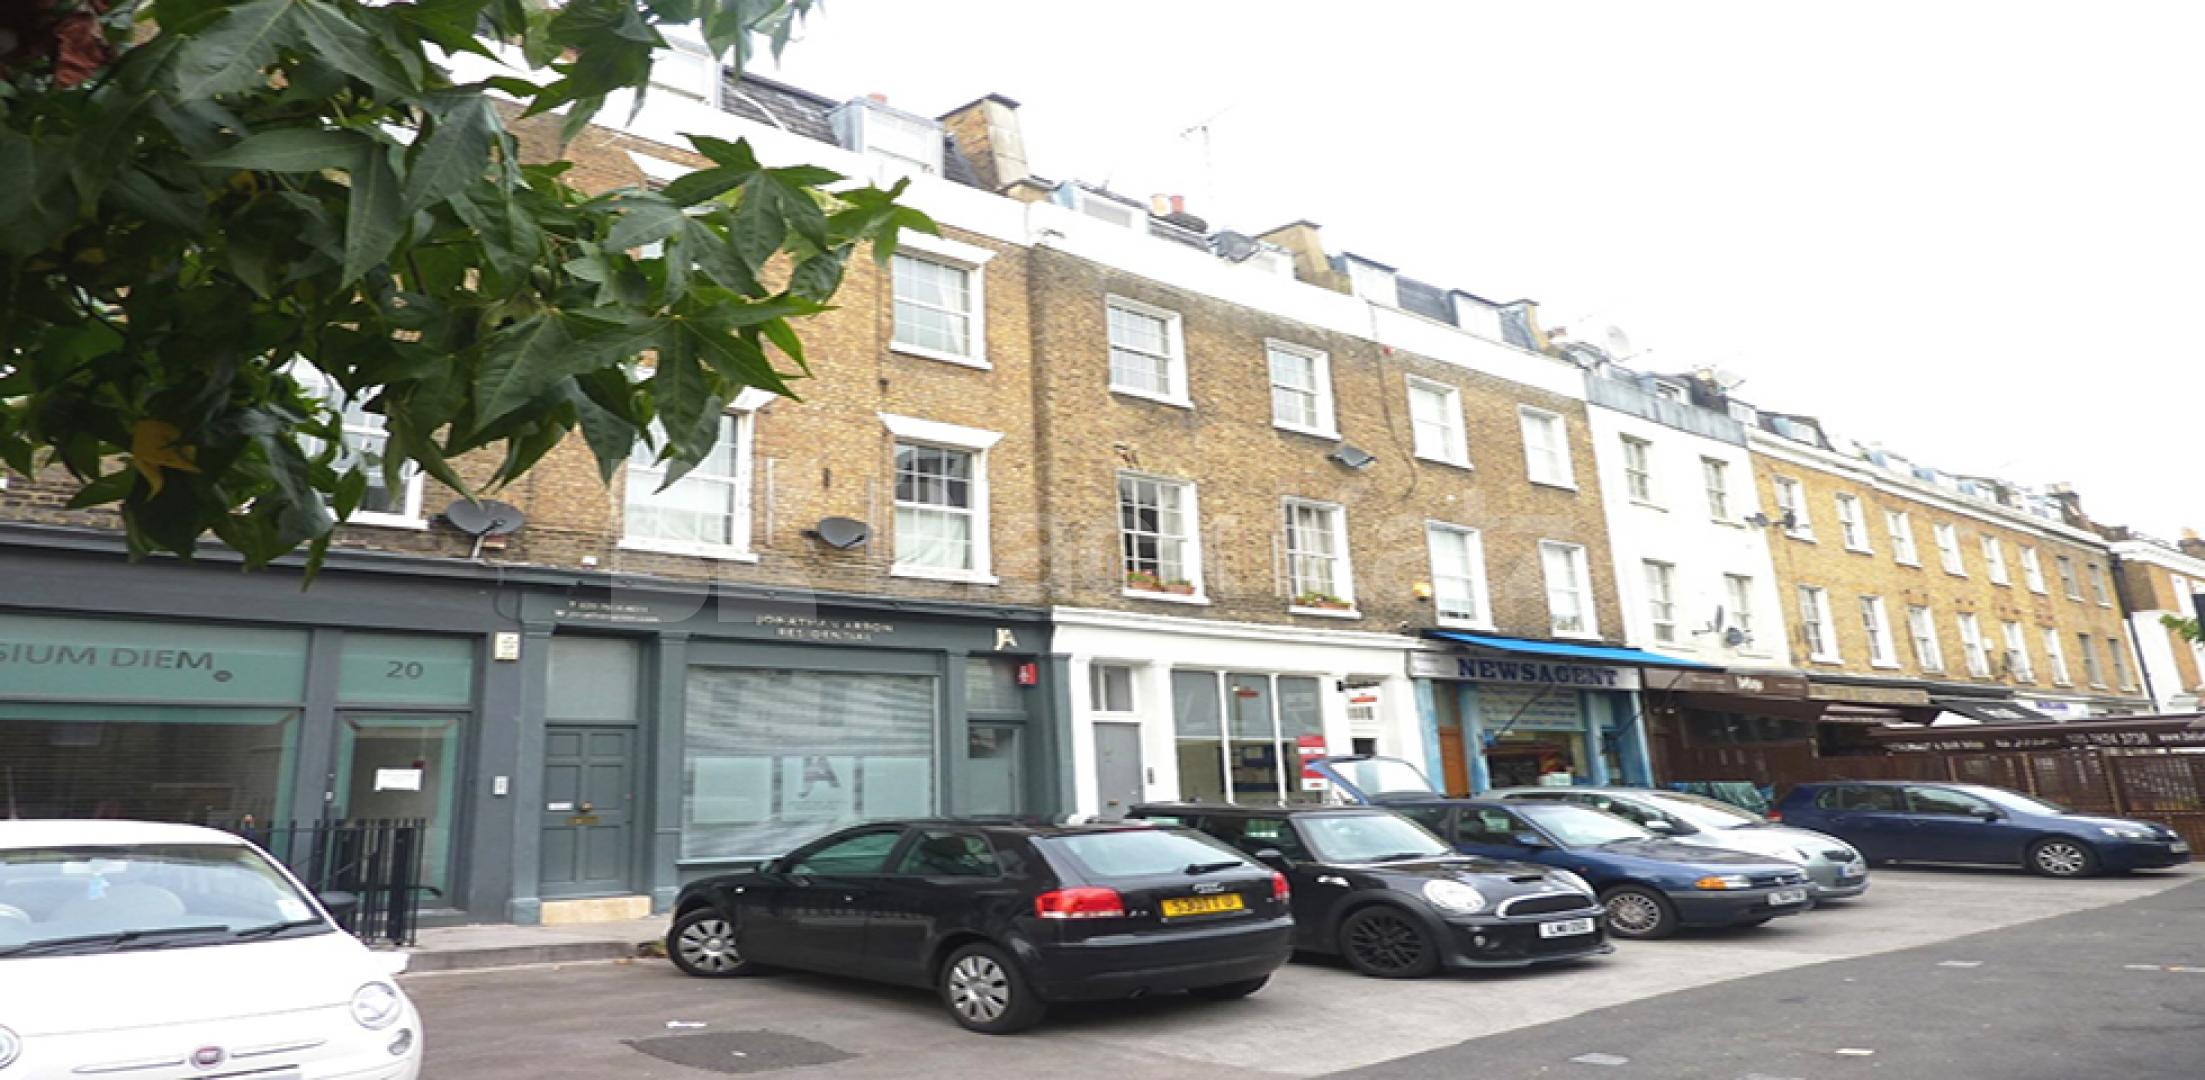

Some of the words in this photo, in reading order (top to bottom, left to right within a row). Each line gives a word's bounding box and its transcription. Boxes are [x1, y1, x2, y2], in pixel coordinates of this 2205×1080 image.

[110, 647, 214, 671] DIEM
[385, 660, 424, 679] 20
[1457, 657, 1618, 686] NEWSAGENT
